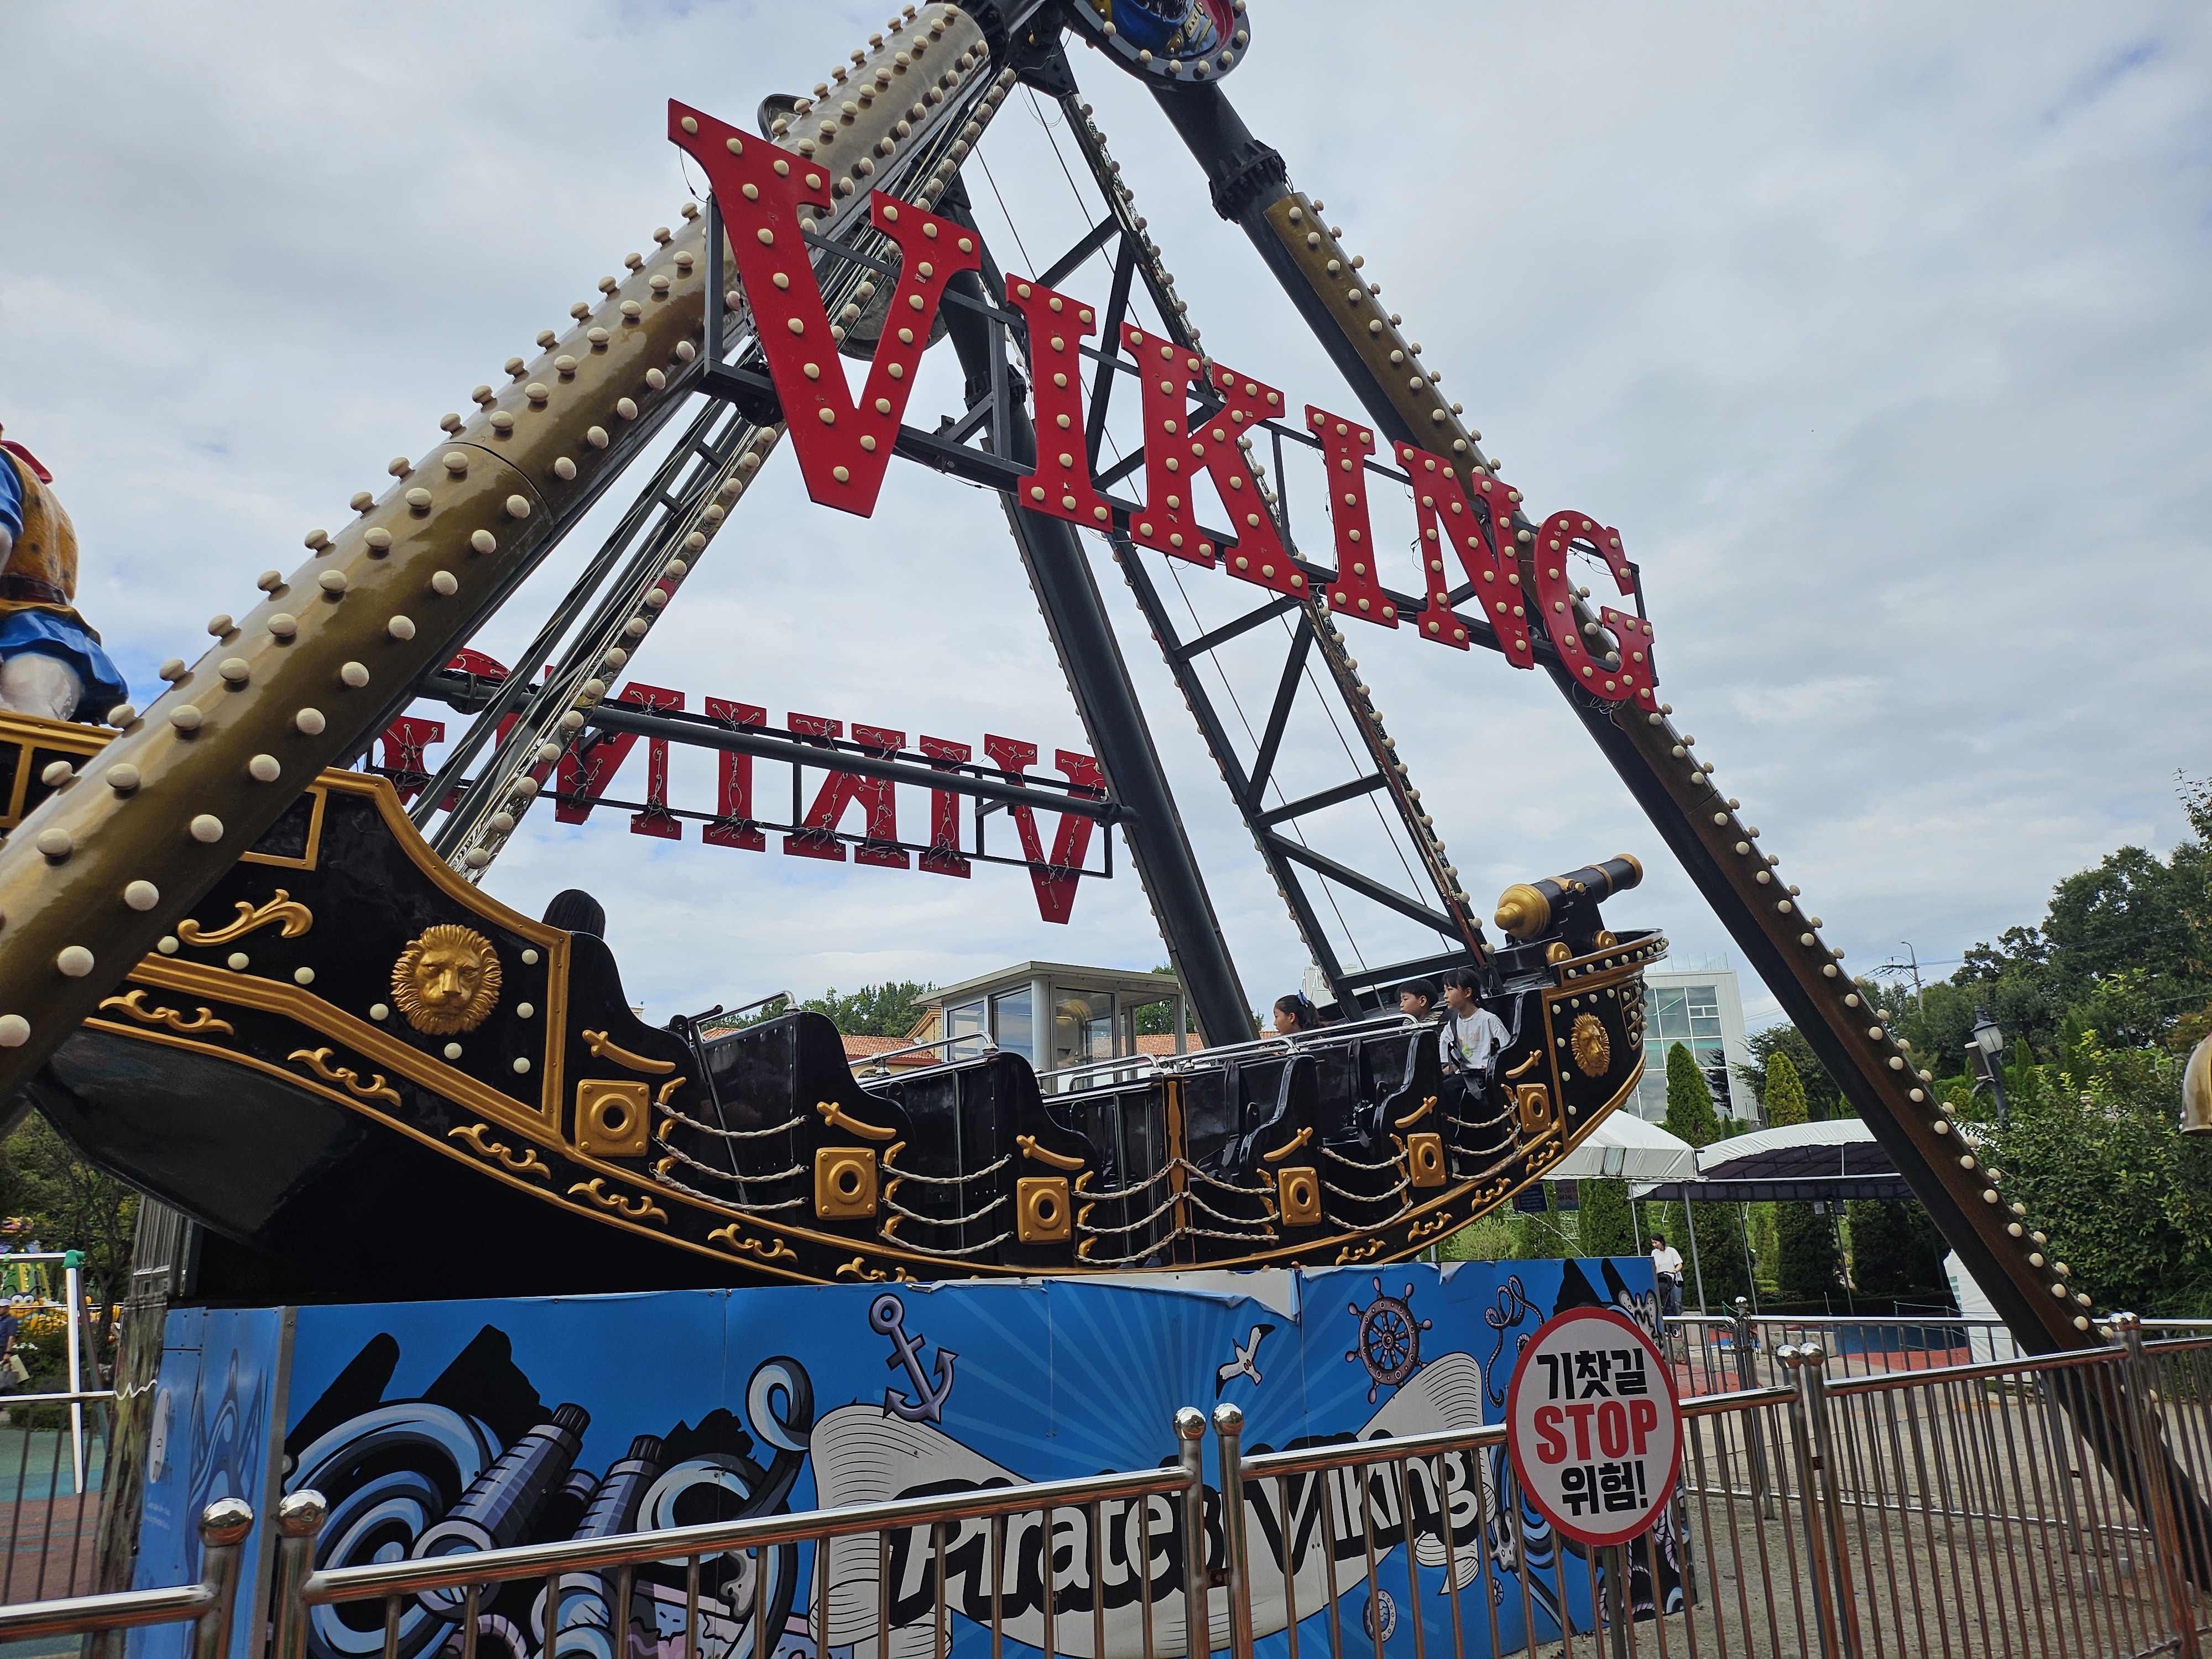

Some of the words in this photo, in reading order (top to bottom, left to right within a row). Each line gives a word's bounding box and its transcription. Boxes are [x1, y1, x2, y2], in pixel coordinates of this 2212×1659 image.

[668, 98, 1658, 712] VIKING
[1536, 1348, 1648, 1400] 기찻길
[1533, 1399, 1658, 1465] STOP
[1256, 1450, 1479, 1556] Viking
[1561, 1460, 1649, 1516] 위험!
